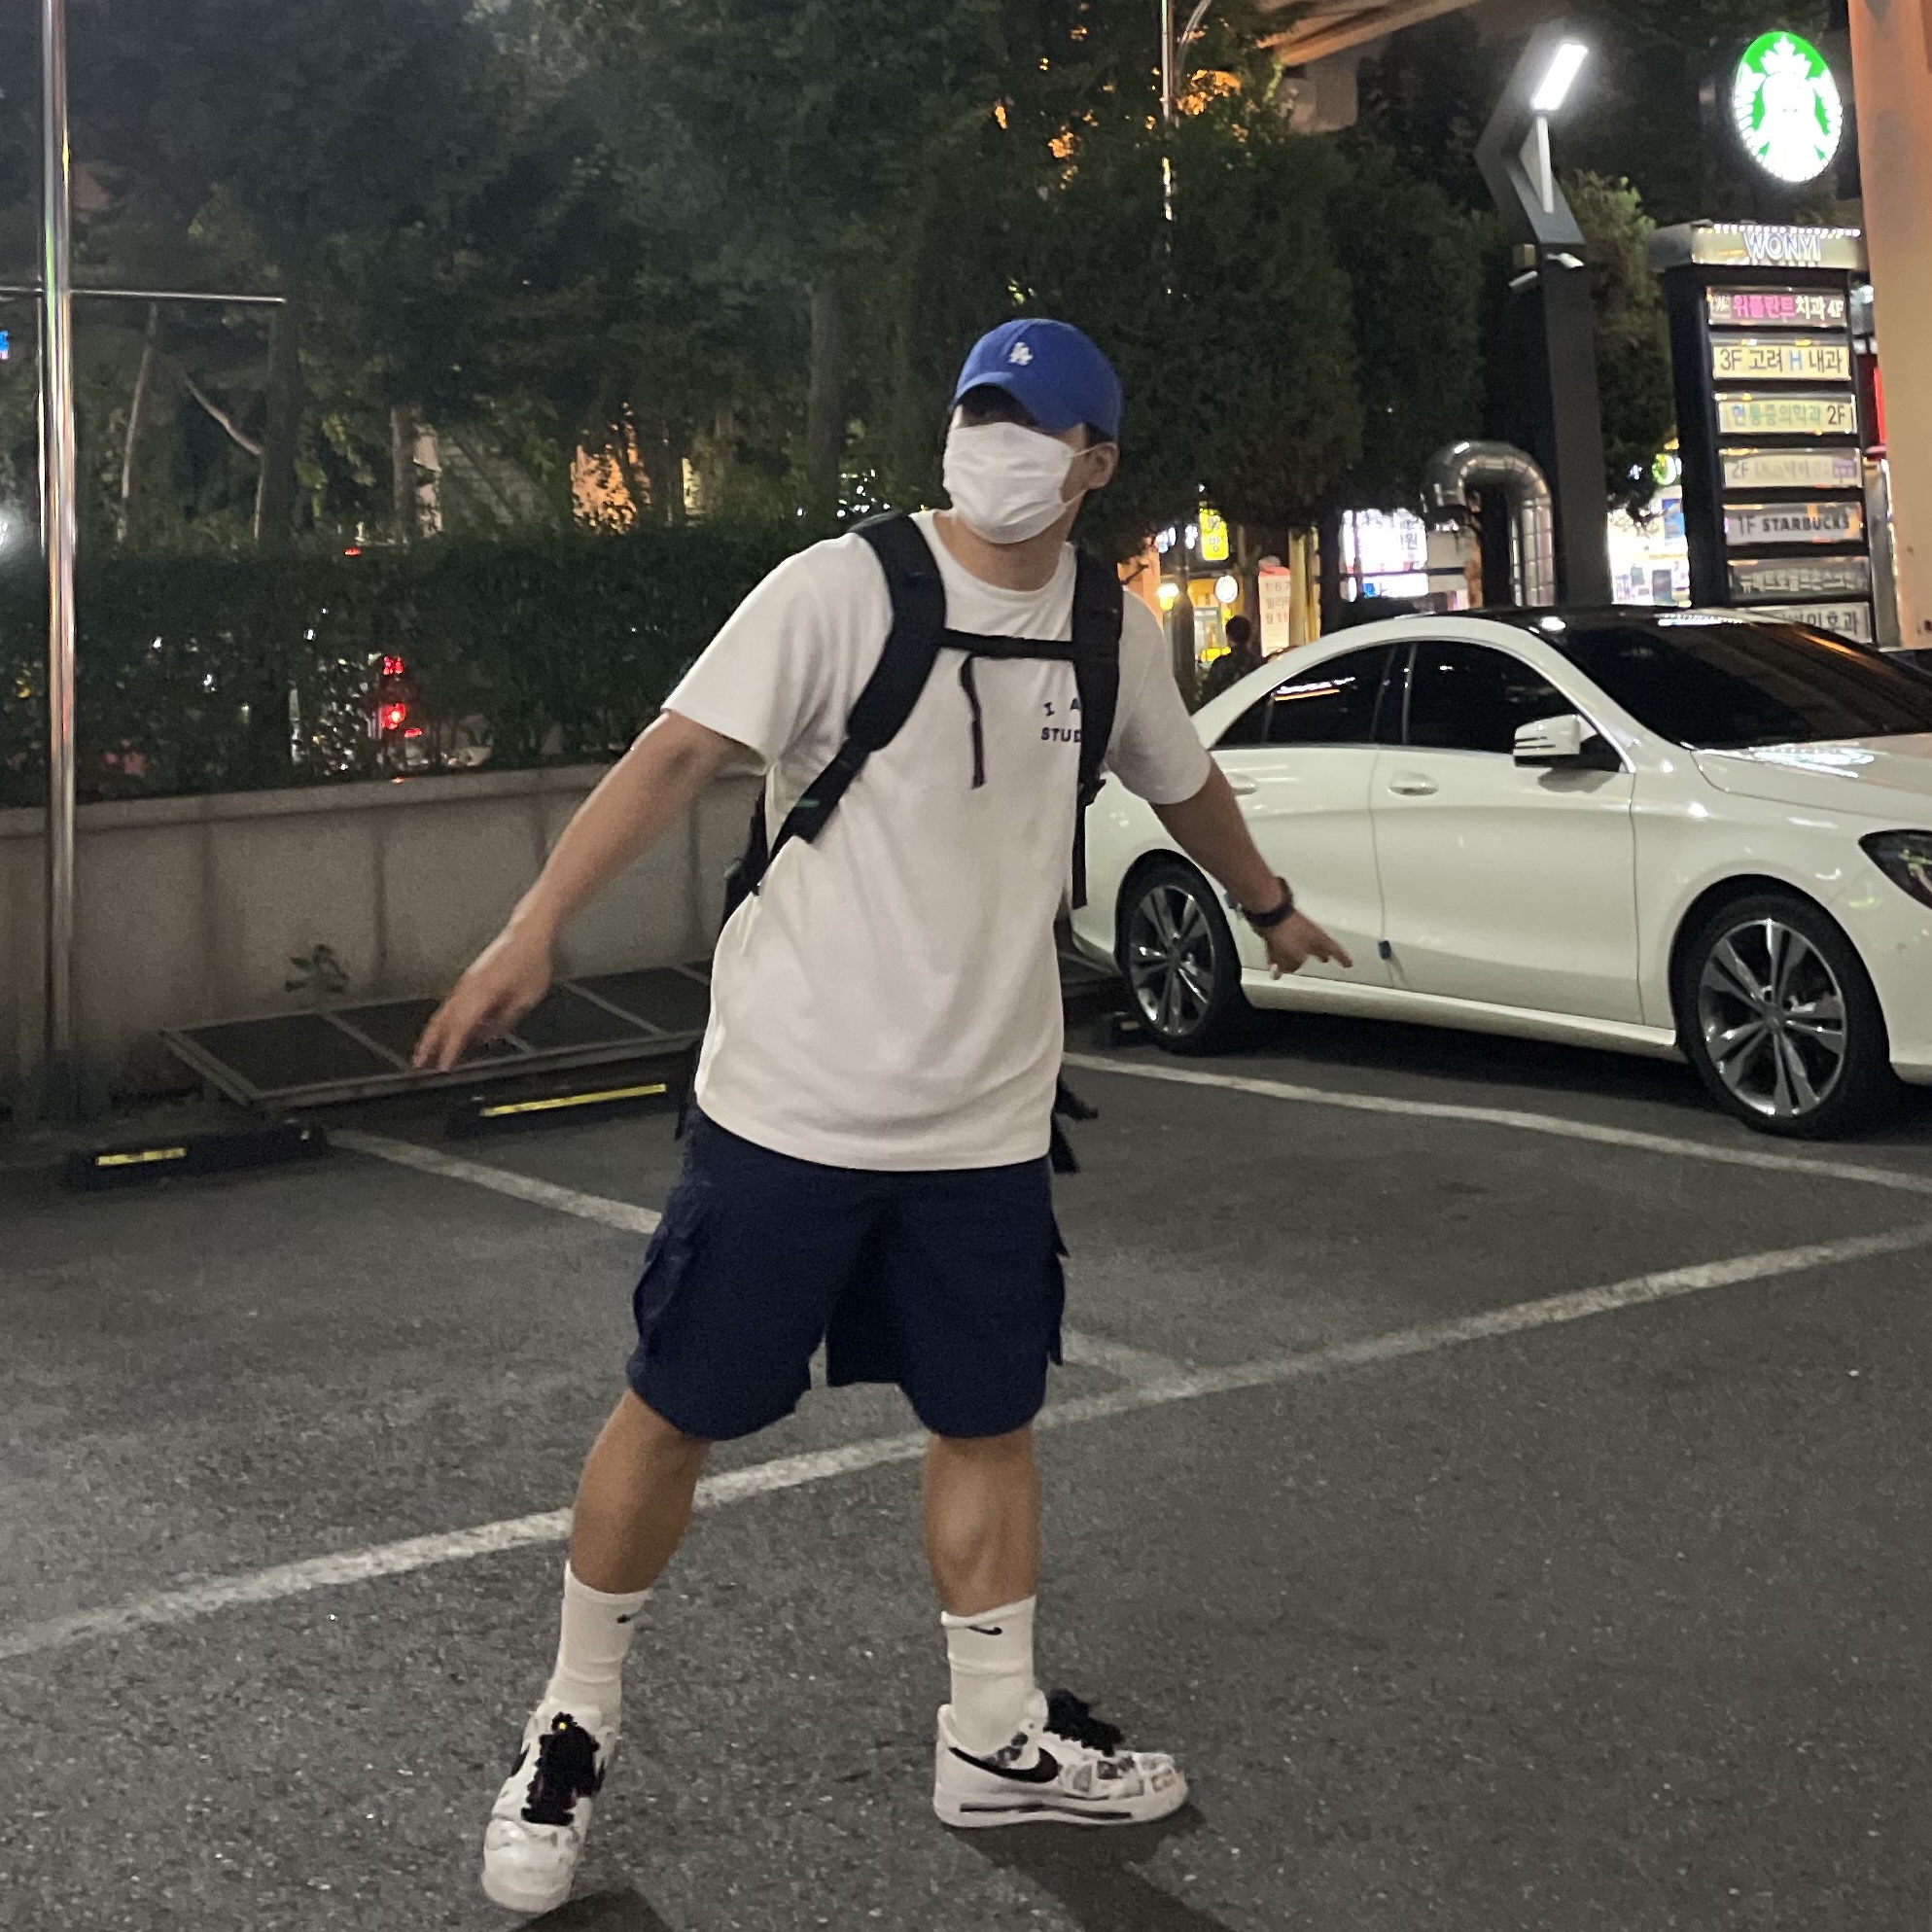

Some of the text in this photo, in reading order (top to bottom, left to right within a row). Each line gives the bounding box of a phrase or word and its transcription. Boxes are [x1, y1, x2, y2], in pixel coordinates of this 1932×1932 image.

[1827, 299, 1844, 318] 4F
[1720, 347, 1843, 373] 3F 고려 H 내과
[1827, 404, 1845, 426] 2F
